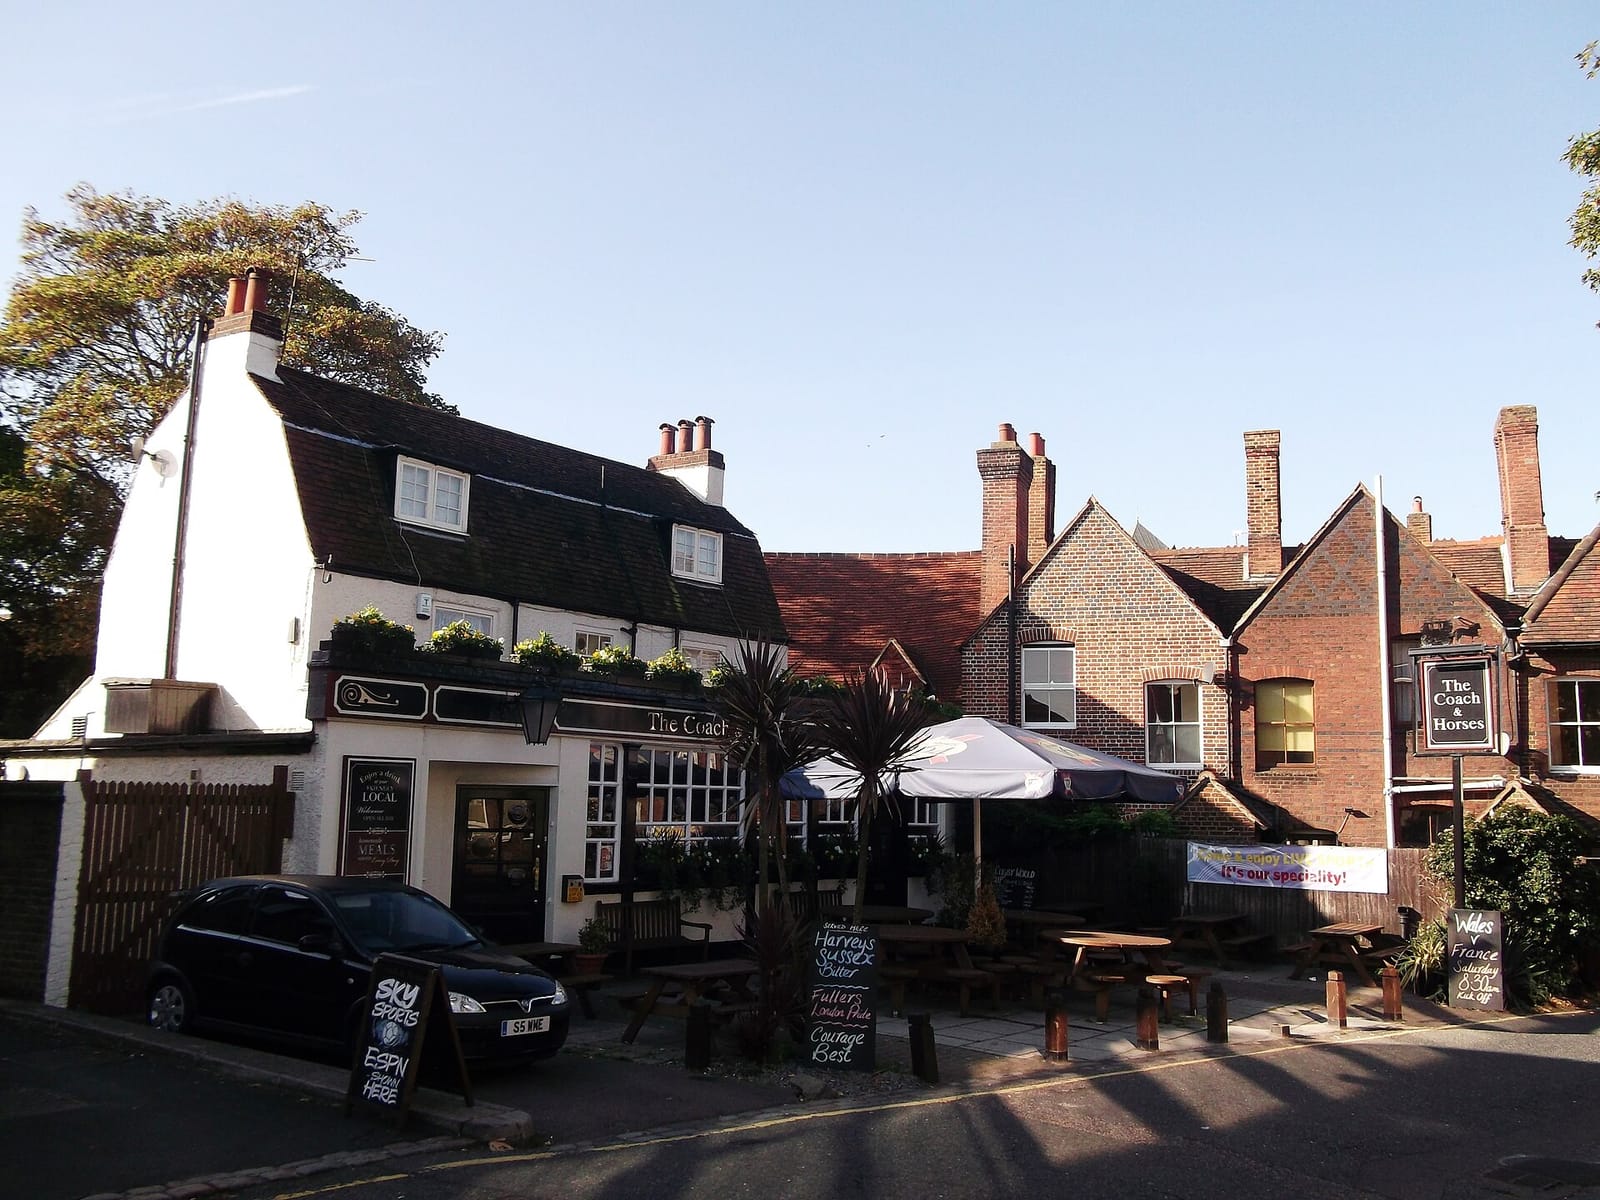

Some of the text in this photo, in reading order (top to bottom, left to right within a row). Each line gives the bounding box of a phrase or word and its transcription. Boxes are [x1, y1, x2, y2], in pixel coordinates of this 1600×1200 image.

[1442, 679, 1471, 692] The
[1434, 692, 1481, 706] Coach
[1453, 707, 1463, 717] &
[648, 711, 679, 732] The
[1433, 718, 1485, 731] Horses
[359, 771, 378, 784] Enjoy
[384, 769, 401, 784] drink
[362, 791, 398, 803] LOCAL
[359, 844, 396, 856] MEALS
[1247, 853, 1280, 866] enjoy
[1221, 865, 1347, 886] It's our speciality!
[823, 921, 869, 932] SERVED HERE
[1454, 912, 1494, 935] Wales
[814, 930, 876, 954] Harveys
[1451, 943, 1499, 961] France
[819, 961, 860, 978] Bitter
[1453, 960, 1499, 979] Saturday
[375, 978, 420, 1009] SKY
[811, 988, 863, 1005] Fullers
[1457, 991, 1475, 1001] Kick
[371, 1001, 421, 1028] SPORTS
[811, 1003, 872, 1020] London Pride
[513, 1021, 526, 1033] S5
[810, 1026, 865, 1050] Courage
[812, 1042, 852, 1064] Best
[363, 1046, 410, 1079] ESPN
[369, 1071, 401, 1089] SHOWN
[362, 1080, 399, 1105] HERE
